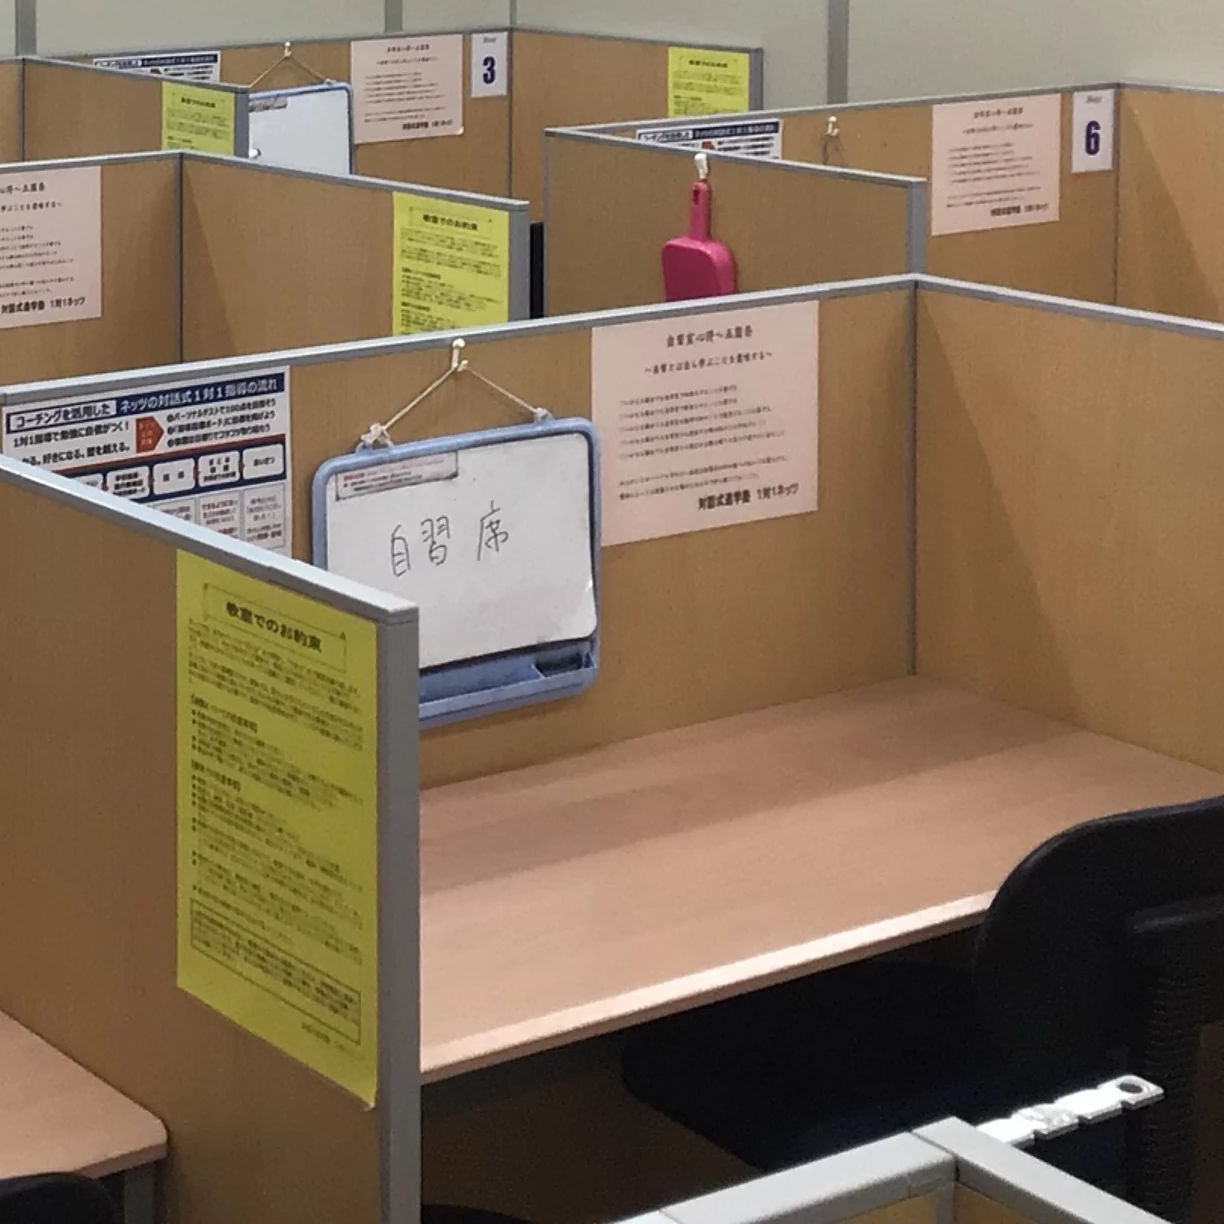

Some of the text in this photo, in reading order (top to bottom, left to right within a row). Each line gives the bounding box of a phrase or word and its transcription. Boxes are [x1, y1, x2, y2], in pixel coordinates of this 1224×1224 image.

[483, 56, 496, 85] 3
[1085, 120, 1102, 155] 6
[390, 499, 509, 578] 自習席
